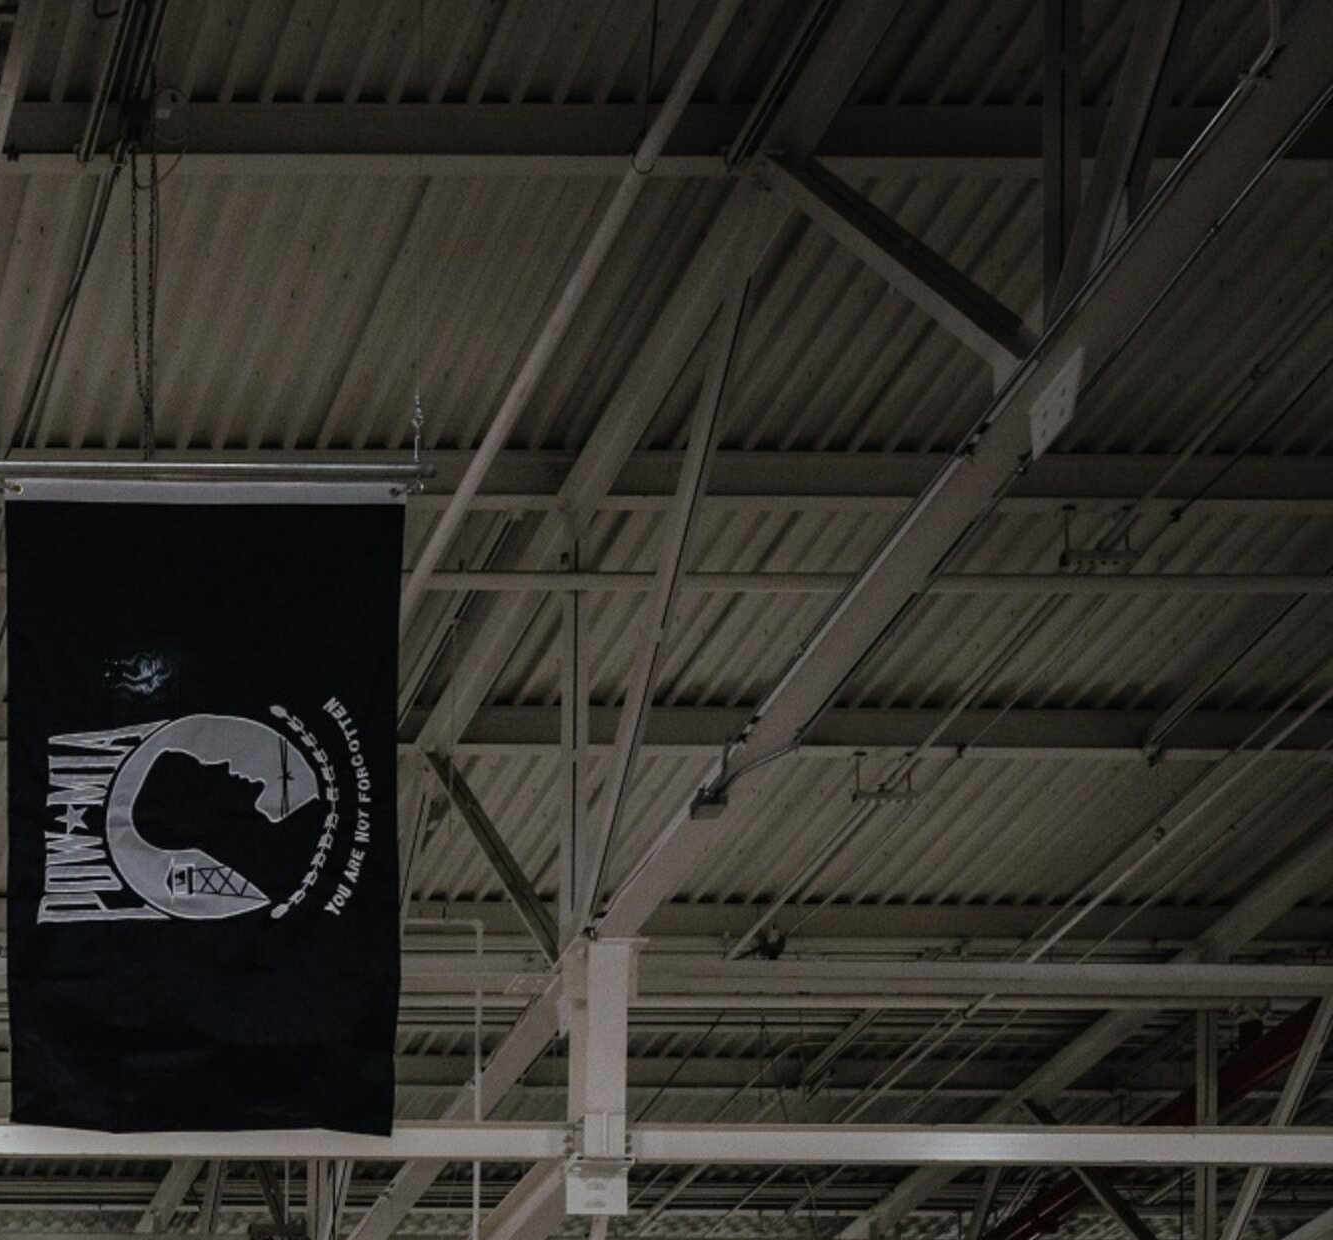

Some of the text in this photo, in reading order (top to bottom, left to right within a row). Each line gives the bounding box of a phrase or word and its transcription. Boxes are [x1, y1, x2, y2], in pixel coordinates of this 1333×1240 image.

[36, 718, 173, 925] POW MIA
[322, 697, 372, 917] YOU ARE NOT FORGOTTEN
